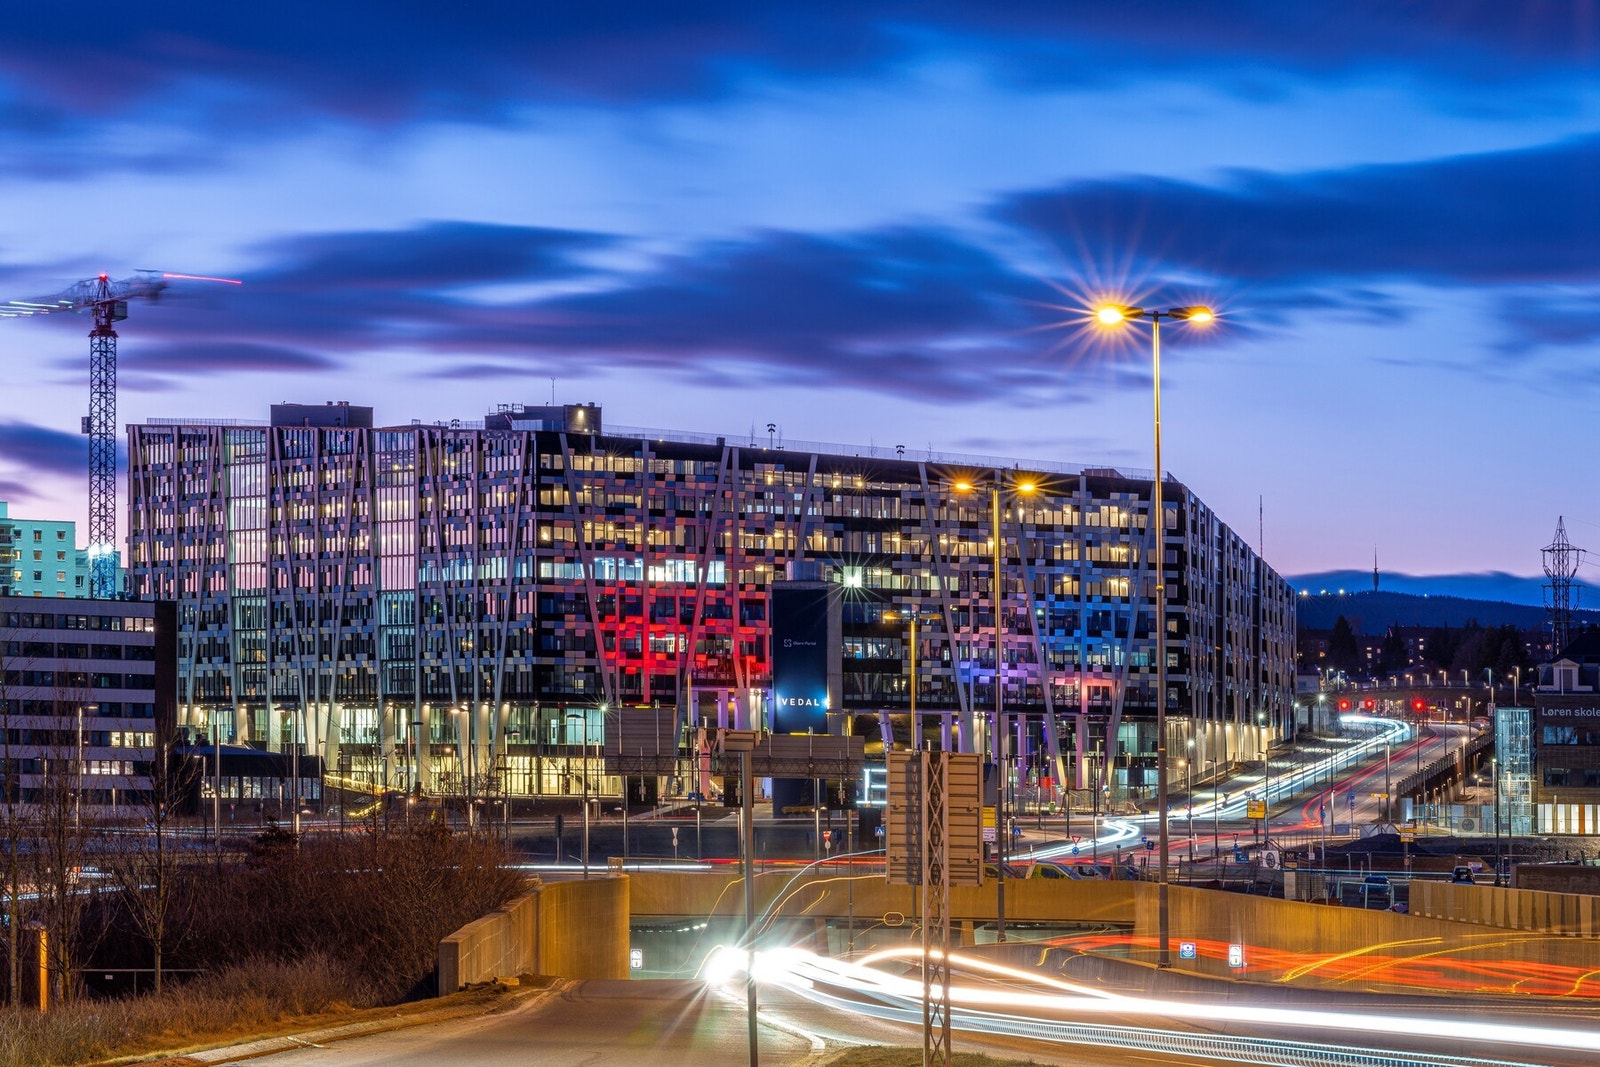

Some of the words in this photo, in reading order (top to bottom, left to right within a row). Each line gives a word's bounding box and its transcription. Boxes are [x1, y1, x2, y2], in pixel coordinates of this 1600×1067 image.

[781, 698, 820, 706] VEDAL
[1542, 707, 1572, 717] Løren
[1574, 707, 1600, 717] skole
